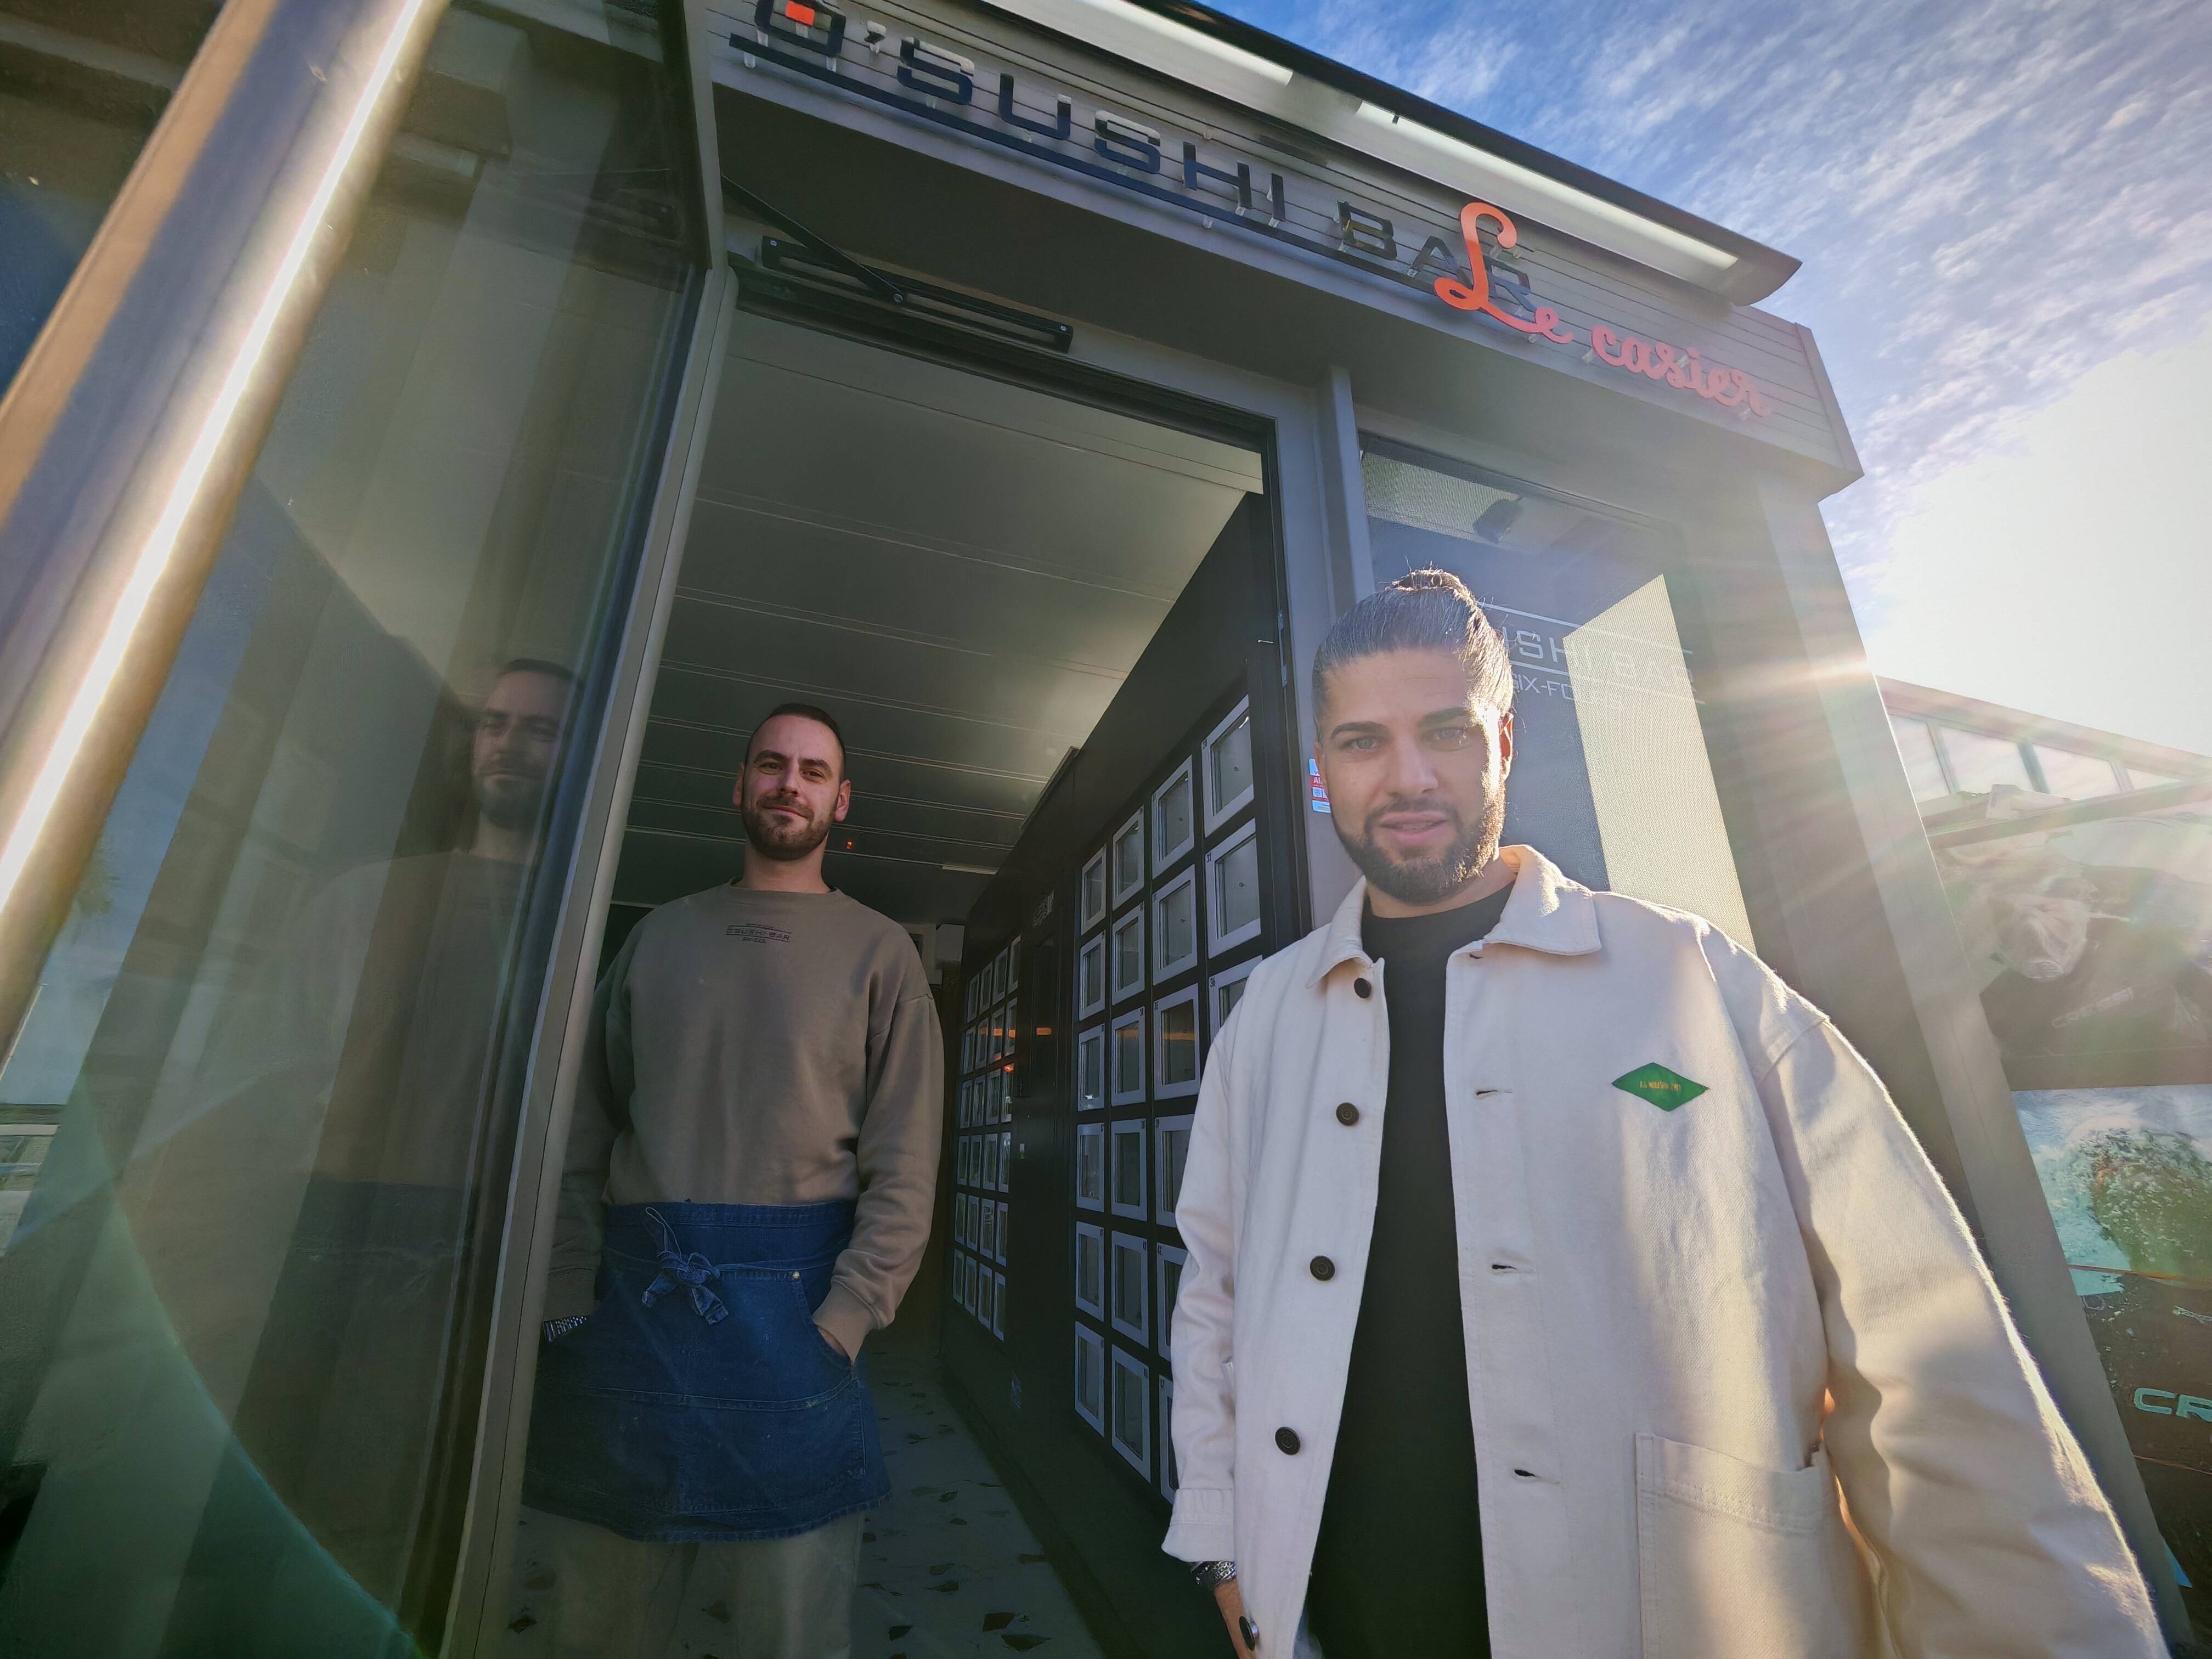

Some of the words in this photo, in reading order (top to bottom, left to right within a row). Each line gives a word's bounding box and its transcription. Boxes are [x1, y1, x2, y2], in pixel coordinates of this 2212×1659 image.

[1336, 199, 1537, 313] BAR
[1434, 202, 1573, 345] Le
[1592, 326, 1773, 418] casier
